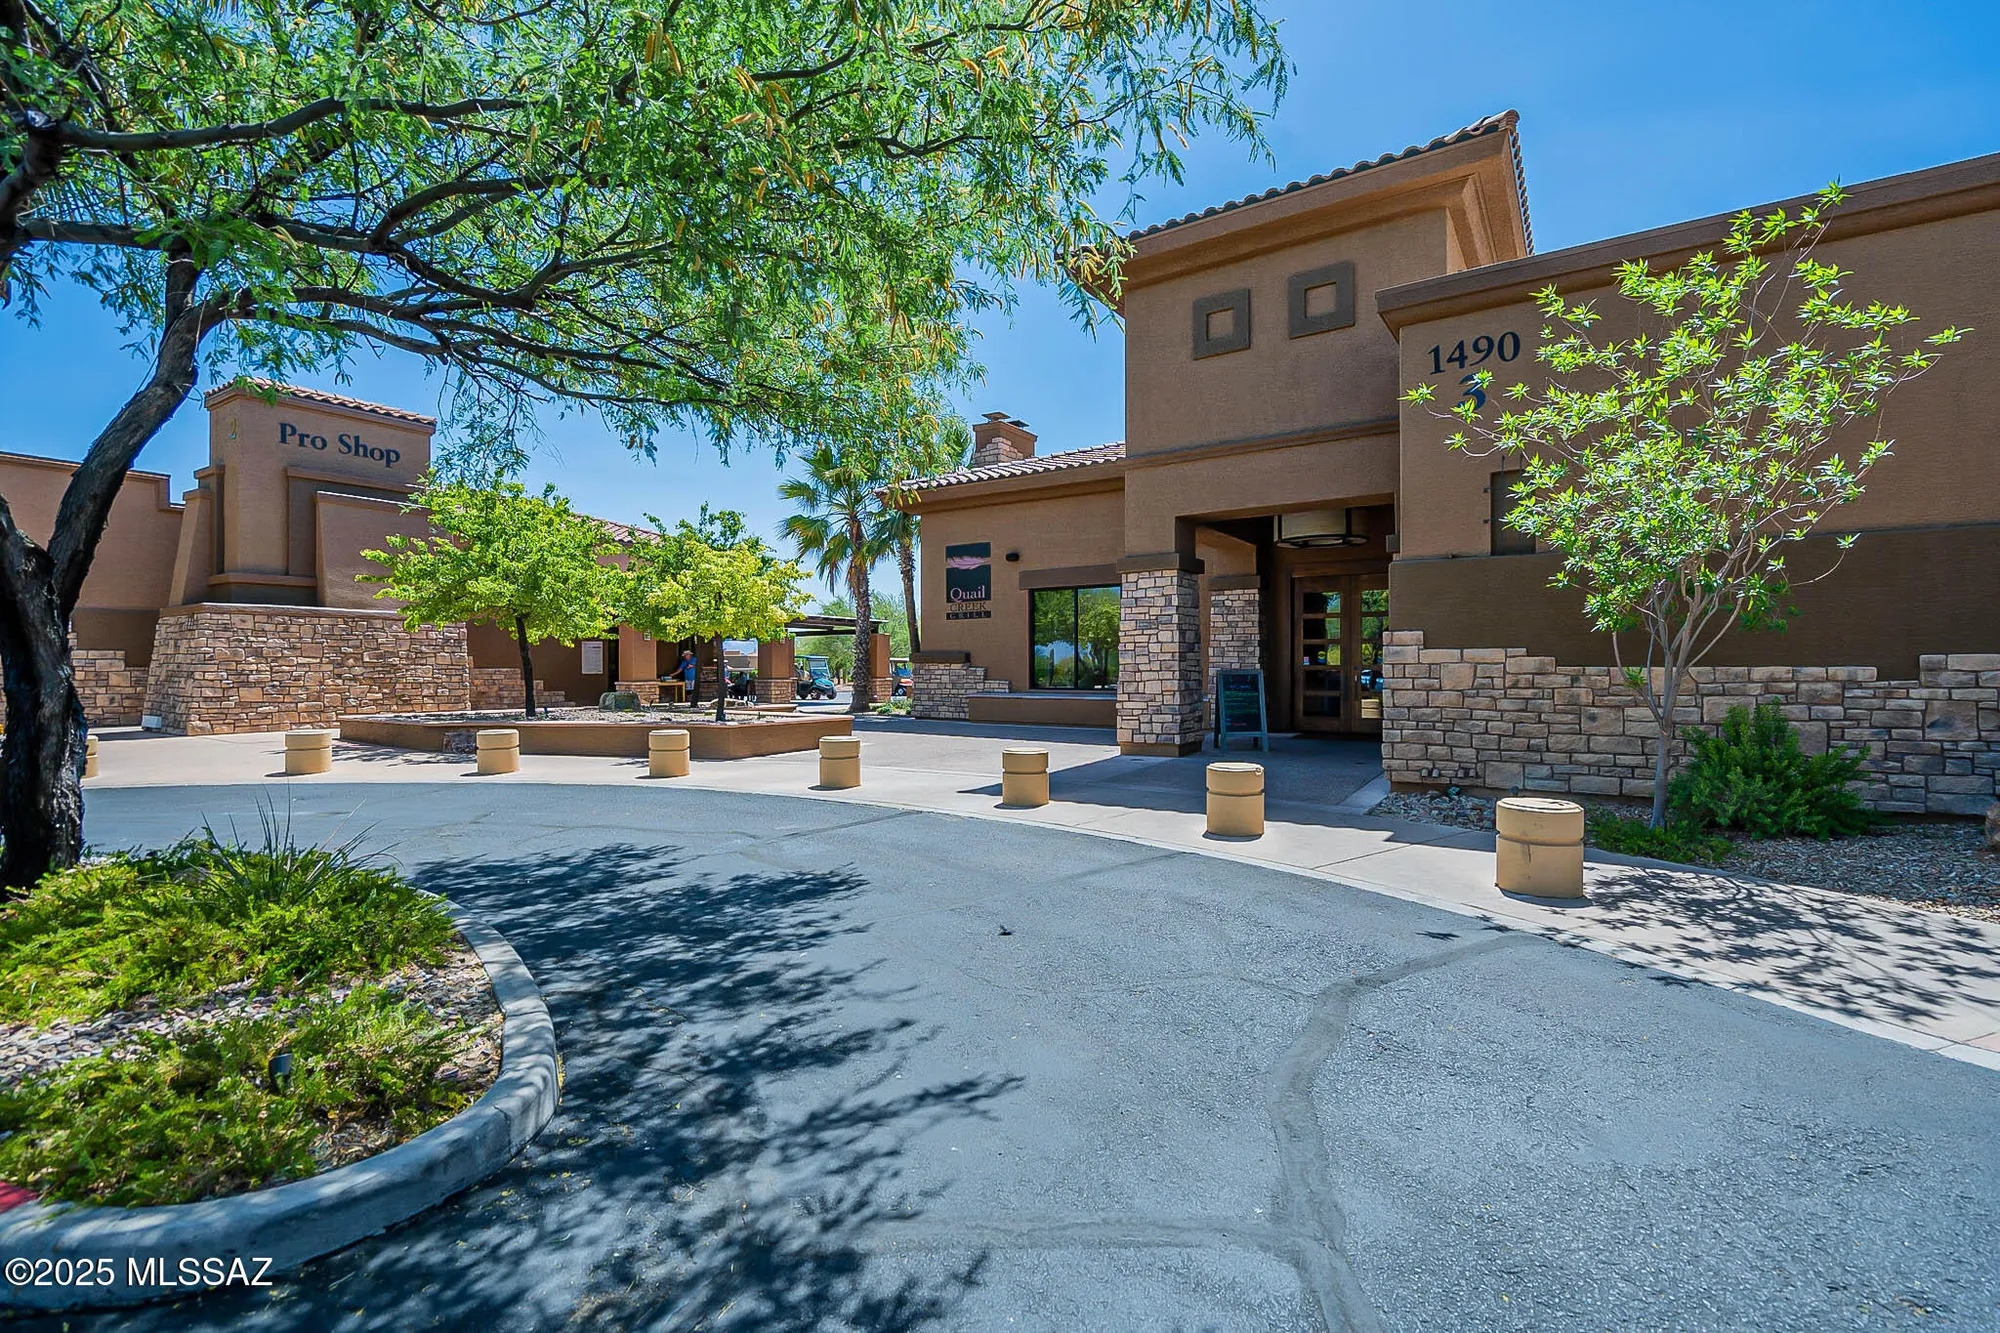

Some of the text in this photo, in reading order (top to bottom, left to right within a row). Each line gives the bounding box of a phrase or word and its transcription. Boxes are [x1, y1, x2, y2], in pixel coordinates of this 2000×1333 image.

[1427, 331, 1521, 375] 1490
[278, 422, 401, 468] Pro Shop
[949, 602, 987, 612] CREEK
[950, 585, 985, 602] Quail
